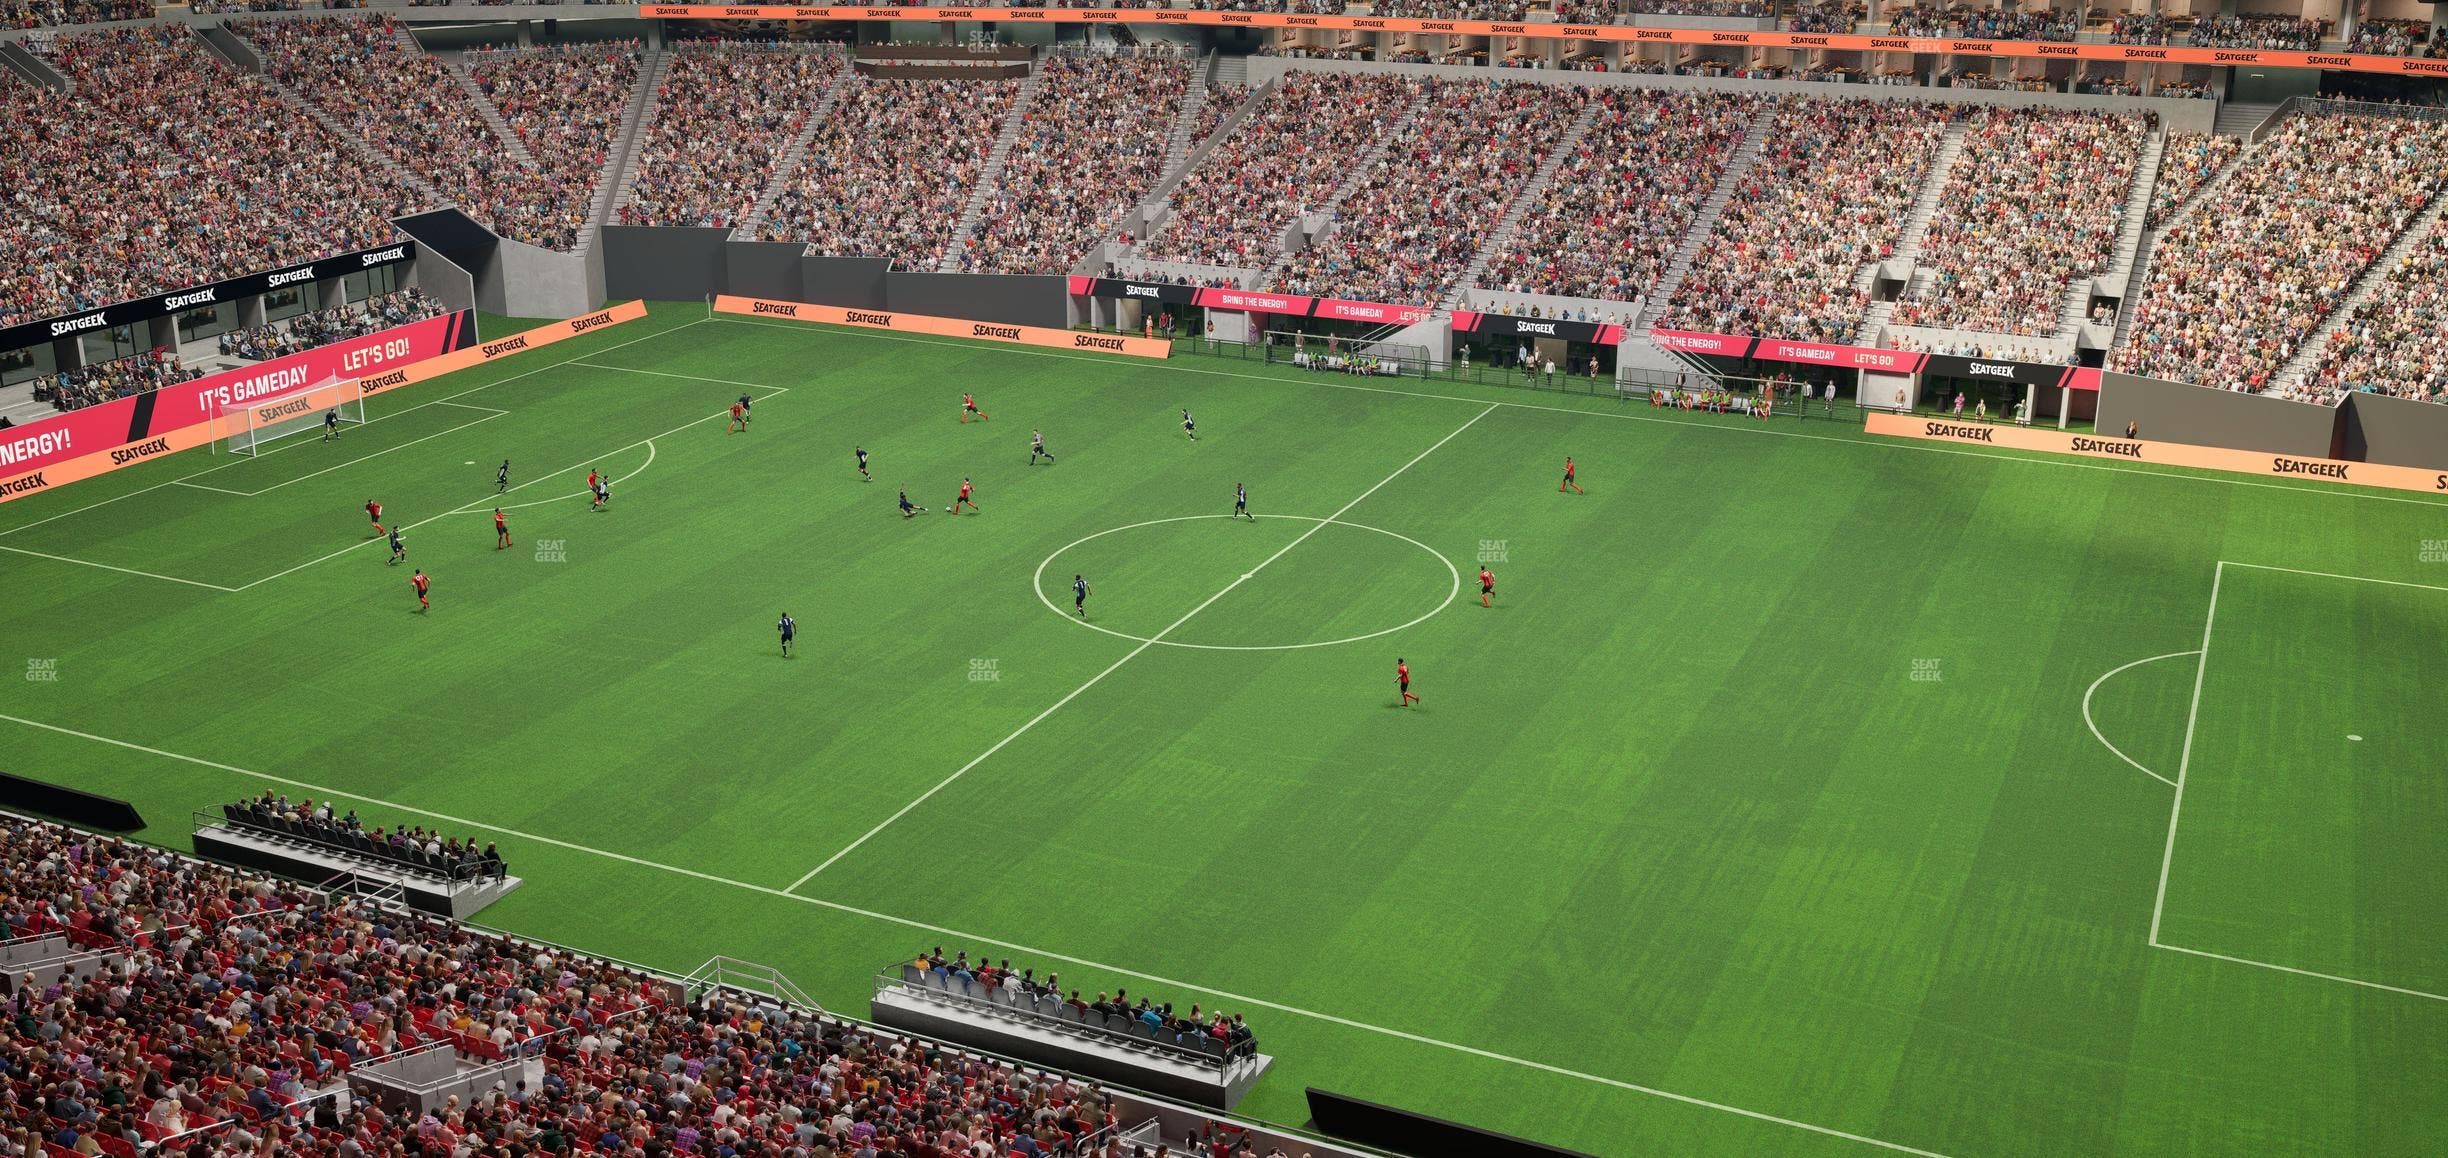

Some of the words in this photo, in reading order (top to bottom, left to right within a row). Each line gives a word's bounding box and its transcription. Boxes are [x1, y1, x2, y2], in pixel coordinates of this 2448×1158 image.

[656, 7, 689, 15] SEATGEEK
[726, 8, 759, 16] SEATGEEK
[796, 9, 829, 17] SEATGEEK
[867, 9, 901, 17] SEATGEEK
[938, 10, 973, 18] SEATGEEK
[1010, 11, 1044, 19] SEATGEEK
[1082, 11, 1117, 19] SEATGEEK
[1155, 12, 1188, 20] SEATGEEK
[1221, 14, 1252, 23] SEATGEEK
[1286, 17, 1317, 25] SEATGEEK
[1353, 19, 1385, 28] SEATGEEK
[1421, 22, 1454, 31] SEATGEEK
[1491, 24, 1525, 34] SEATGEEK
[1563, 27, 1597, 36] SEATGEEK
[1637, 30, 1673, 39] SEATGEEK
[1712, 33, 1750, 43] SEATGEEK
[1791, 36, 1828, 46] SEATGEEK
[1870, 39, 1909, 49] SEATGEEK
[1953, 42, 1993, 52] SEATGEEK
[2037, 45, 2078, 55] SEATGEEK
[2124, 48, 2167, 59] SEATGEEK
[2214, 52, 2258, 62] SEATGEEK
[2307, 55, 2351, 67] SEATGEEK
[362, 245, 405, 267] SEATGEEK
[268, 266, 315, 287] SEATGEEK
[1126, 284, 1160, 298] SEATGEEK
[164, 287, 216, 311] SEATGEEK
[1222, 294, 1244, 305] BRING
[1245, 296, 1258, 307] THE
[1259, 298, 1288, 309] ENERGY!
[753, 301, 797, 317] SEATGEEK
[1335, 305, 1349, 315] IT'S
[1350, 306, 1384, 318] GAMEDAY
[51, 311, 108, 336] SEATGEEK
[571, 311, 614, 333] SEATGEEK
[845, 311, 892, 327] SEATGEEK
[973, 324, 1022, 341] SEATGEEK
[1516, 320, 1556, 335] SEATGEEK
[482, 335, 529, 359] SEATGEEK
[1074, 334, 1125, 351] SEATGEEK
[1671, 336, 1687, 347] THE
[1687, 337, 1722, 350] ENERGY!
[1779, 346, 1795, 357] IT'S
[1796, 347, 1836, 360] GAMEDAY
[1854, 353, 1878, 365] LET'S
[1879, 355, 1894, 366] GO!
[198, 385, 231, 411] IT'S
[233, 364, 308, 402] GAMEDAY
[343, 345, 383, 372] LET'S
[386, 337, 410, 360] GO!
[1969, 362, 2016, 378] SEATGEEK
[360, 369, 408, 394] SEATGEEK
[258, 397, 312, 423] SEATGEEK
[1925, 421, 1994, 443] SEATGEEK
[0, 428, 71, 467] NERGY!
[110, 437, 171, 466] SEATGEEK
[2071, 437, 2143, 458] SEATGEEK
[2272, 457, 2350, 480] SEATGEEK
